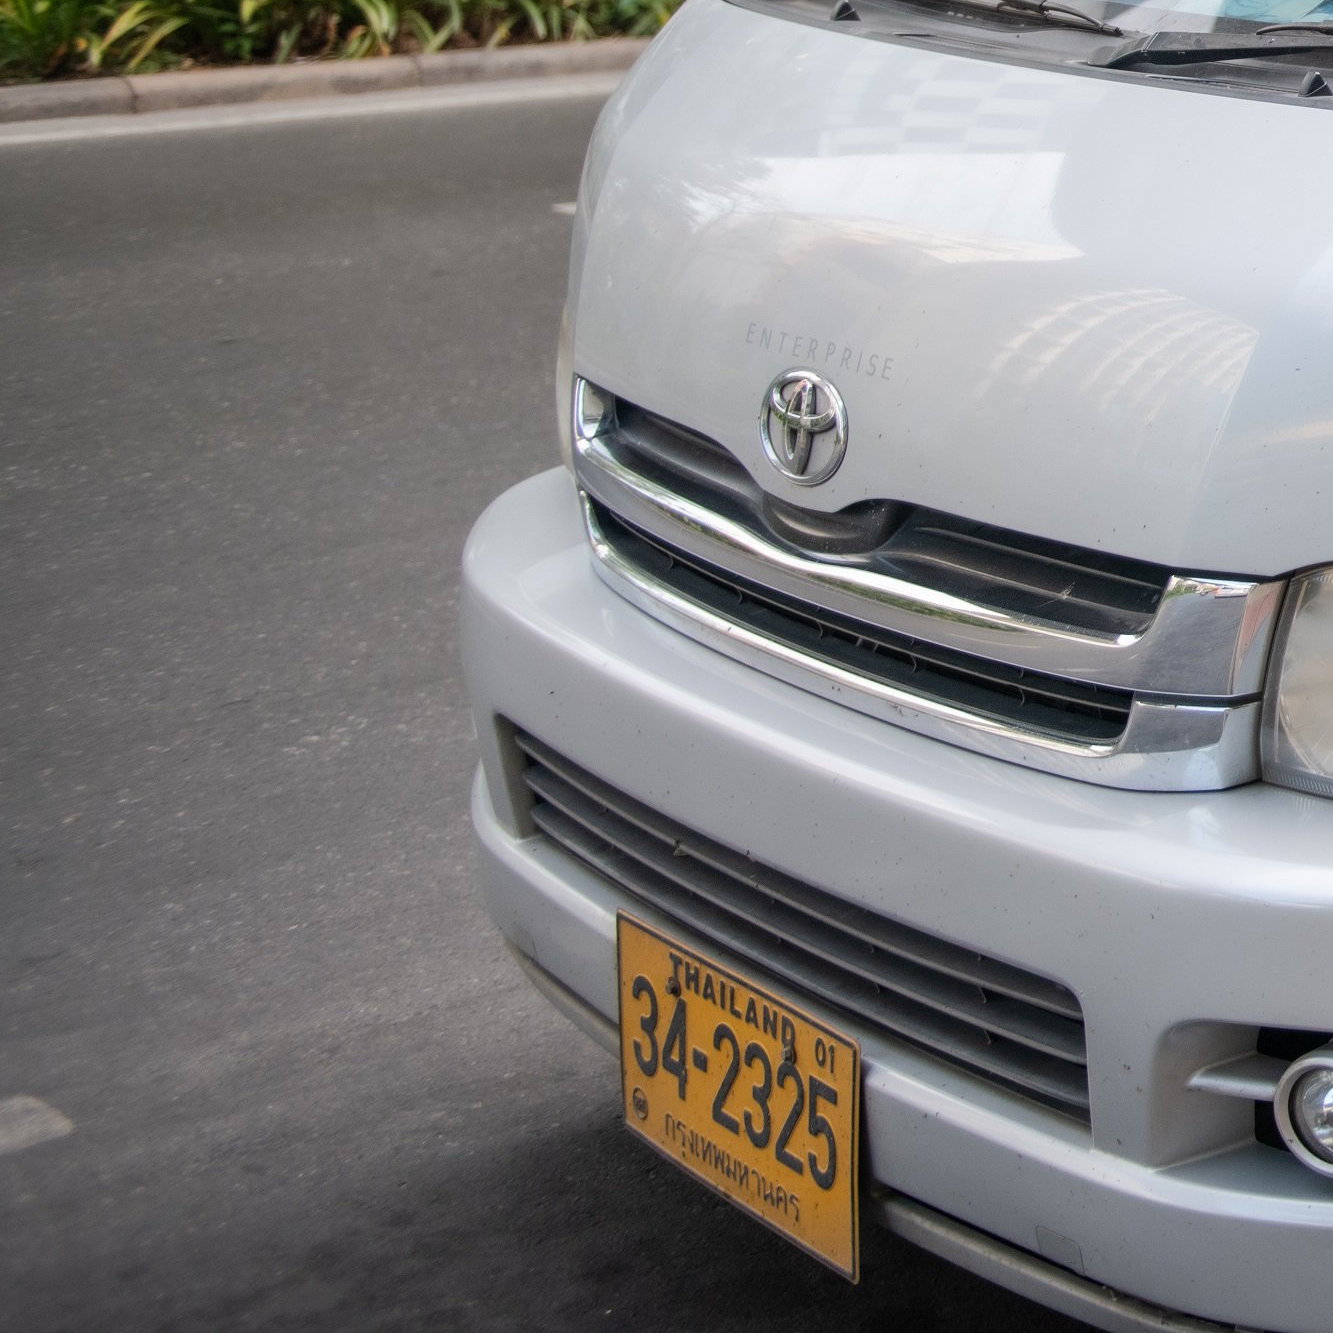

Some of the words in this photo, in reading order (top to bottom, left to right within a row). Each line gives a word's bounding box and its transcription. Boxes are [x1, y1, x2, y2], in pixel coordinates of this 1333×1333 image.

[745, 322, 895, 380] ENTERPRISE
[668, 951, 797, 1047] THAILAND
[815, 1036, 836, 1074] 01
[632, 974, 838, 1191] 34-2325
[665, 1112, 800, 1222] กรุงเทพมหานคร
